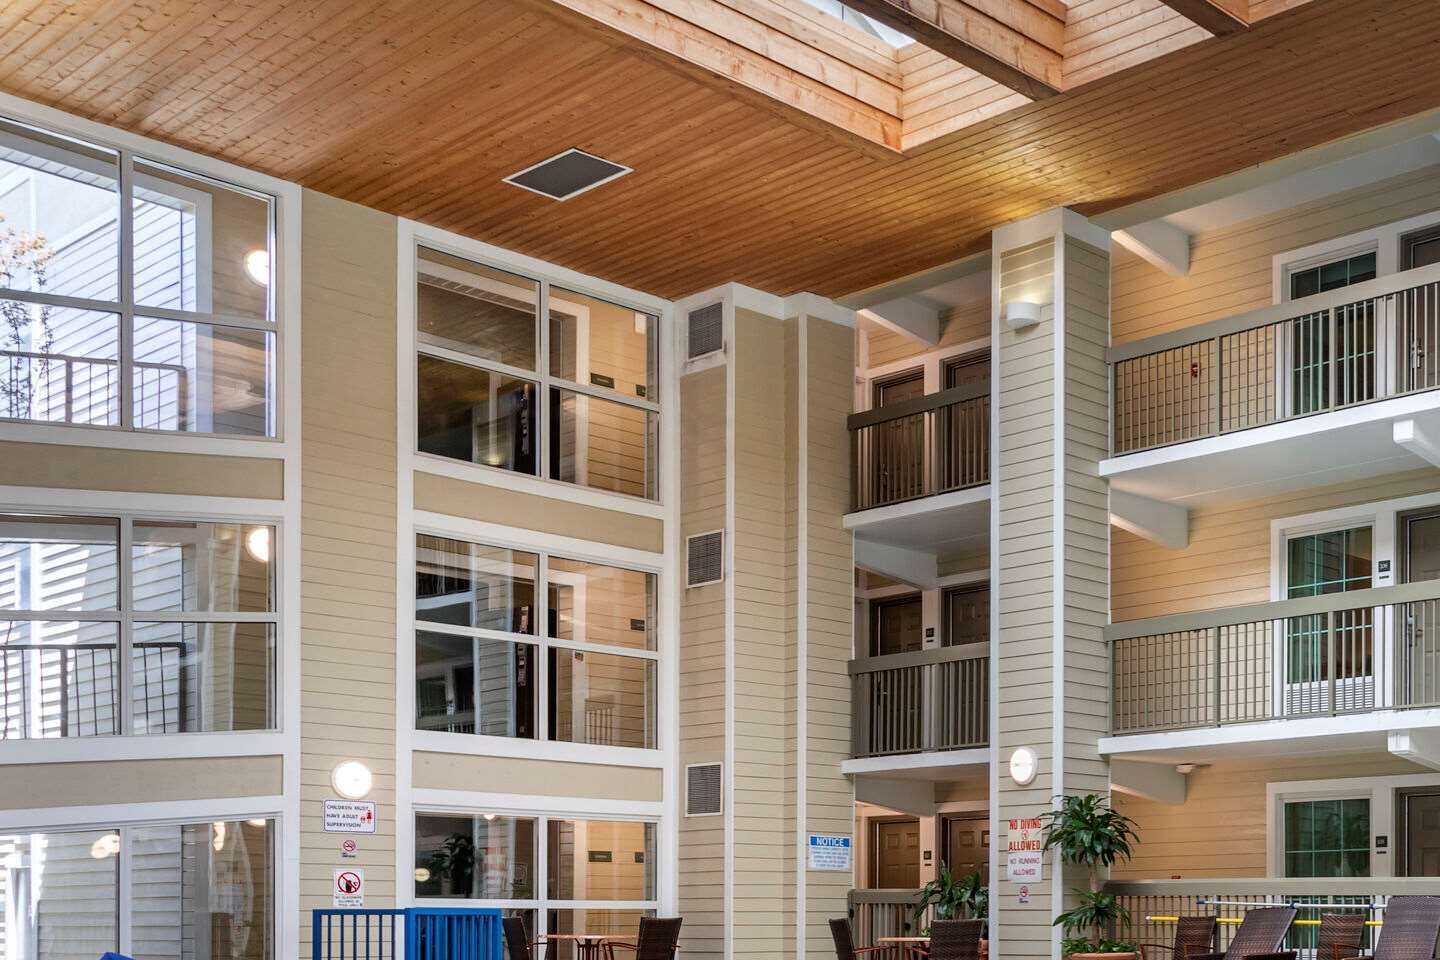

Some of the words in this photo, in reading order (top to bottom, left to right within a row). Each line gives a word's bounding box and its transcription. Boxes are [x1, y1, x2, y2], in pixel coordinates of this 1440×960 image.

[1009, 819, 1018, 829] NO
[1020, 819, 1041, 829] DIVING
[816, 838, 845, 847] NOTICE
[1008, 840, 1040, 851] ALLOWED
